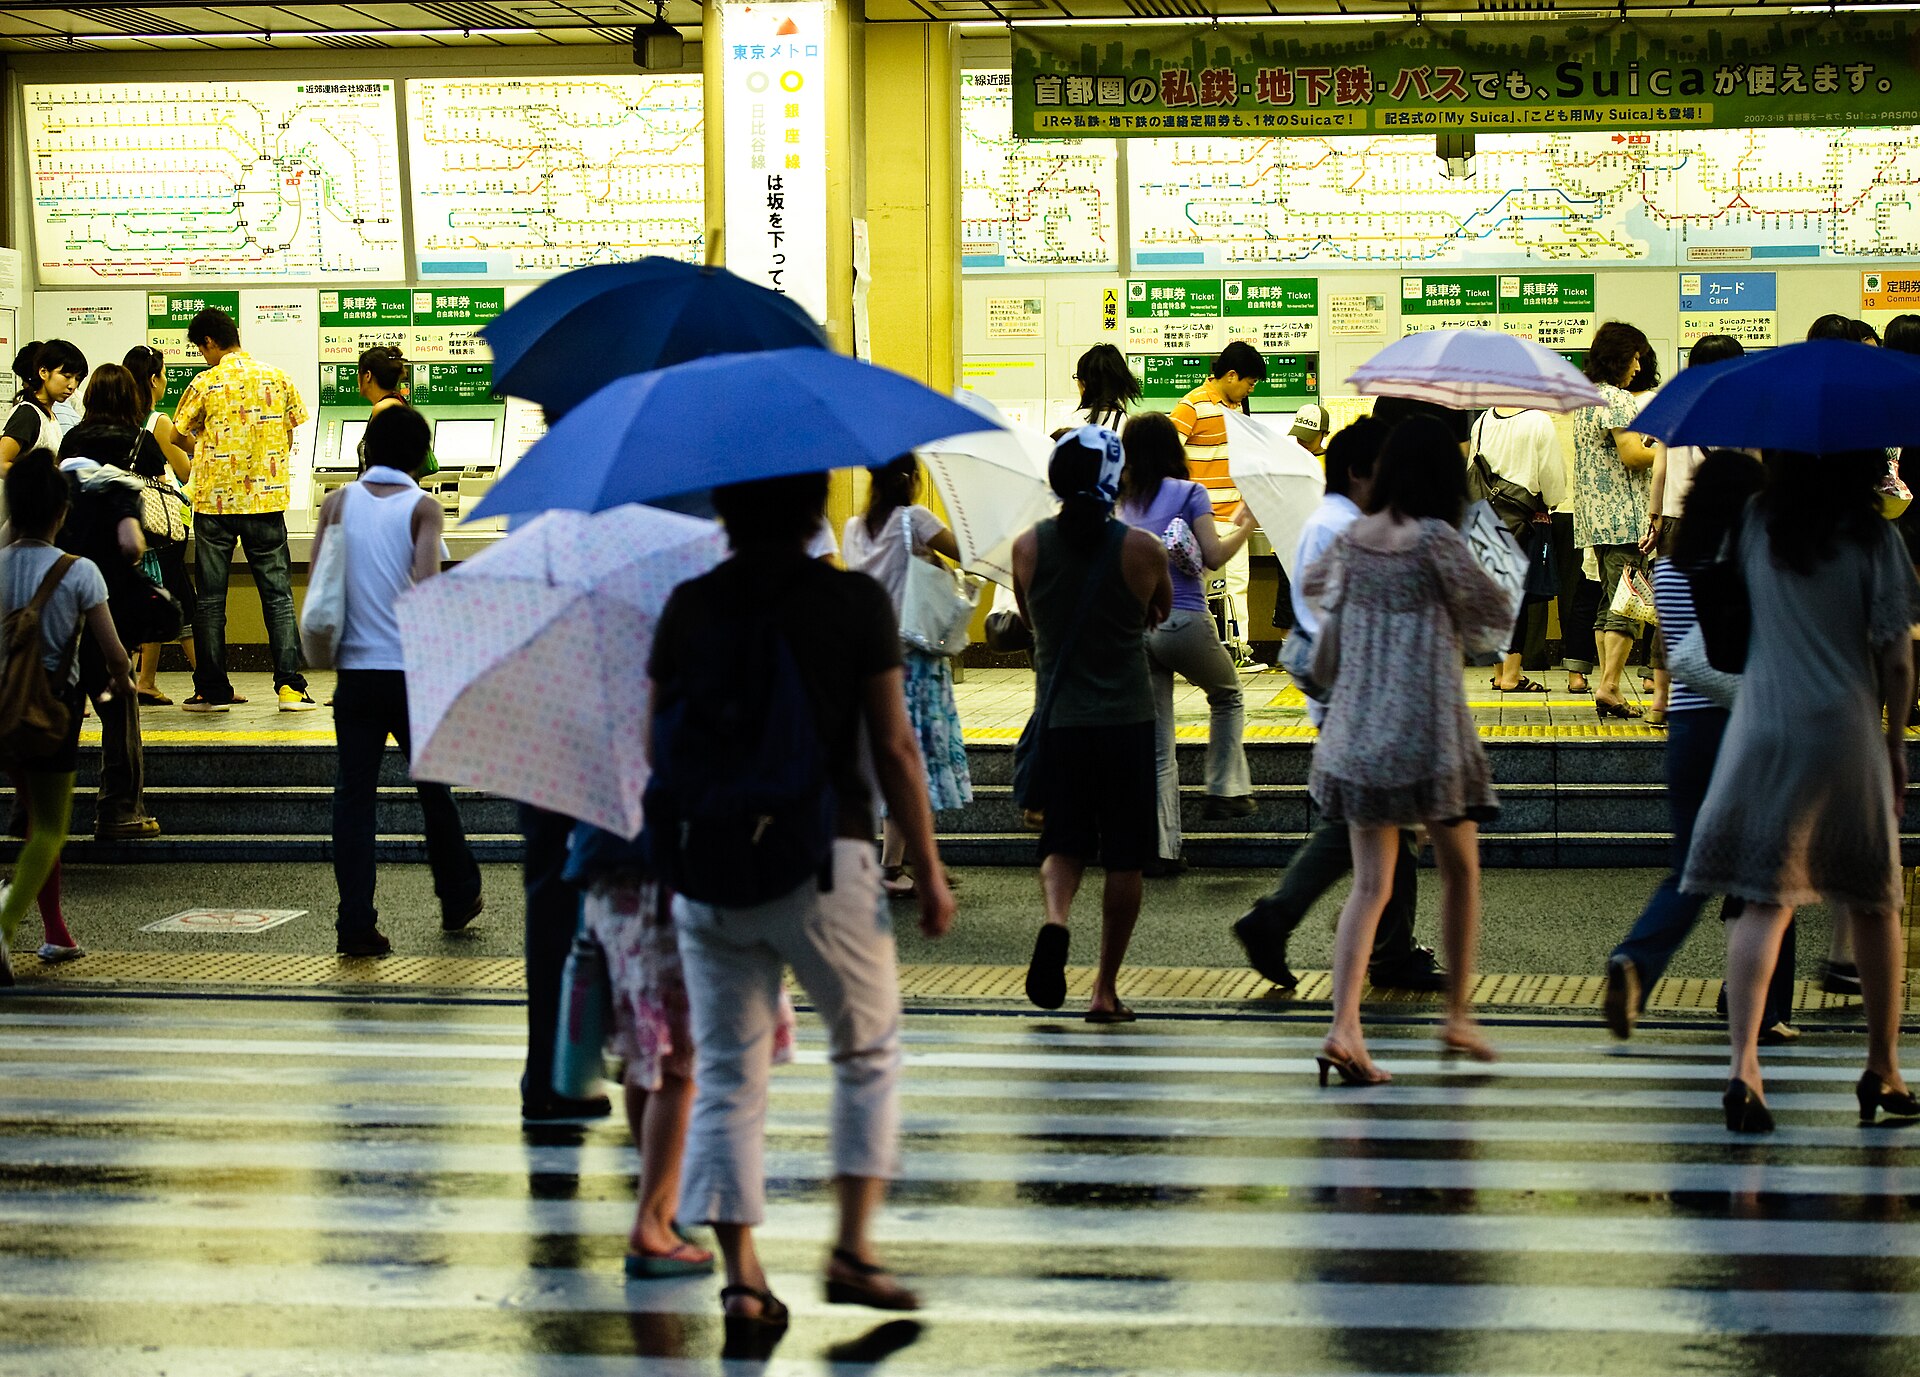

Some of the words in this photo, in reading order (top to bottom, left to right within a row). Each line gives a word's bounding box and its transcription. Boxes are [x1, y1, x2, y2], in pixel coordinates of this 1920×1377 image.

[732, 44, 818, 60] 東京メトロ
[751, 104, 766, 169] 日比谷線
[784, 103, 800, 169] 銀座線
[1246, 286, 1282, 299] 乗車券
[1287, 292, 1311, 300] Ticket
[1425, 284, 1461, 297] 乗車券
[1465, 289, 1490, 297] Ticket
[1523, 282, 1559, 295] 乗車券
[1563, 288, 1588, 296] Ticket
[1709, 281, 1745, 295] カード
[1886, 280, 1920, 293] 定期券
[1150, 287, 1186, 300] 乗車券
[1190, 293, 1215, 301] Ticket
[171, 299, 205, 312] 乗車券
[342, 297, 377, 310] 乗車券
[381, 302, 405, 310] Ticket
[435, 295, 471, 309] 乗車券
[474, 301, 499, 309] Ticket
[1681, 300, 1693, 309] 12
[1864, 298, 1876, 307] 13
[1104, 290, 1118, 329] 入場券
[1129, 326, 1159, 334] Suica
[1503, 322, 1533, 330] Suica
[1684, 320, 1714, 328] Suica
[324, 335, 353, 343] Suica
[415, 334, 444, 342] Suica
[1147, 357, 1174, 367] きっぷ
[167, 368, 193, 377] きっぷ
[339, 366, 360, 375] きっ
[432, 365, 458, 375] きっぷ
